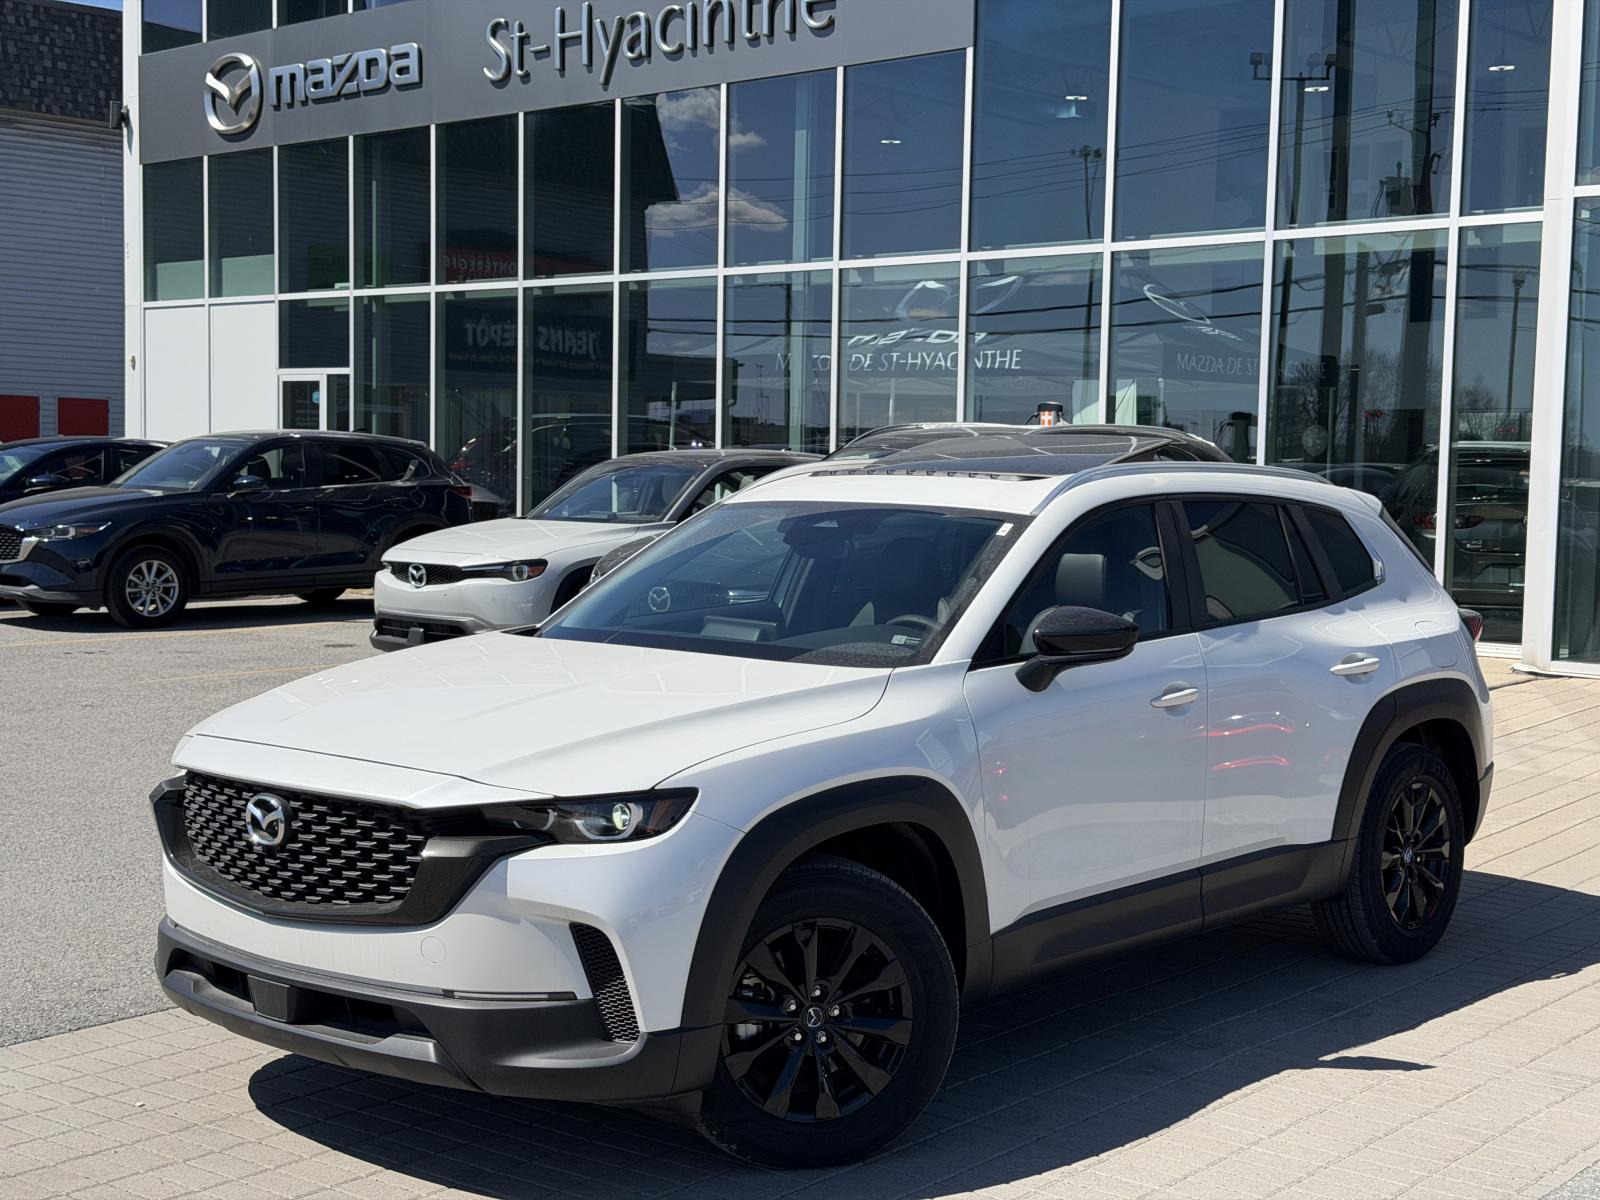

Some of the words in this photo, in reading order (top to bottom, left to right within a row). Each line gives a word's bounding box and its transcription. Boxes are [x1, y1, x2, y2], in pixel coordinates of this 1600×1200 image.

[482, 0, 836, 85] St-Hyacinthe
[848, 353, 873, 372] DE
[878, 349, 1023, 372] ST-HYACNTHE
[1176, 352, 1225, 375] MAZDA
